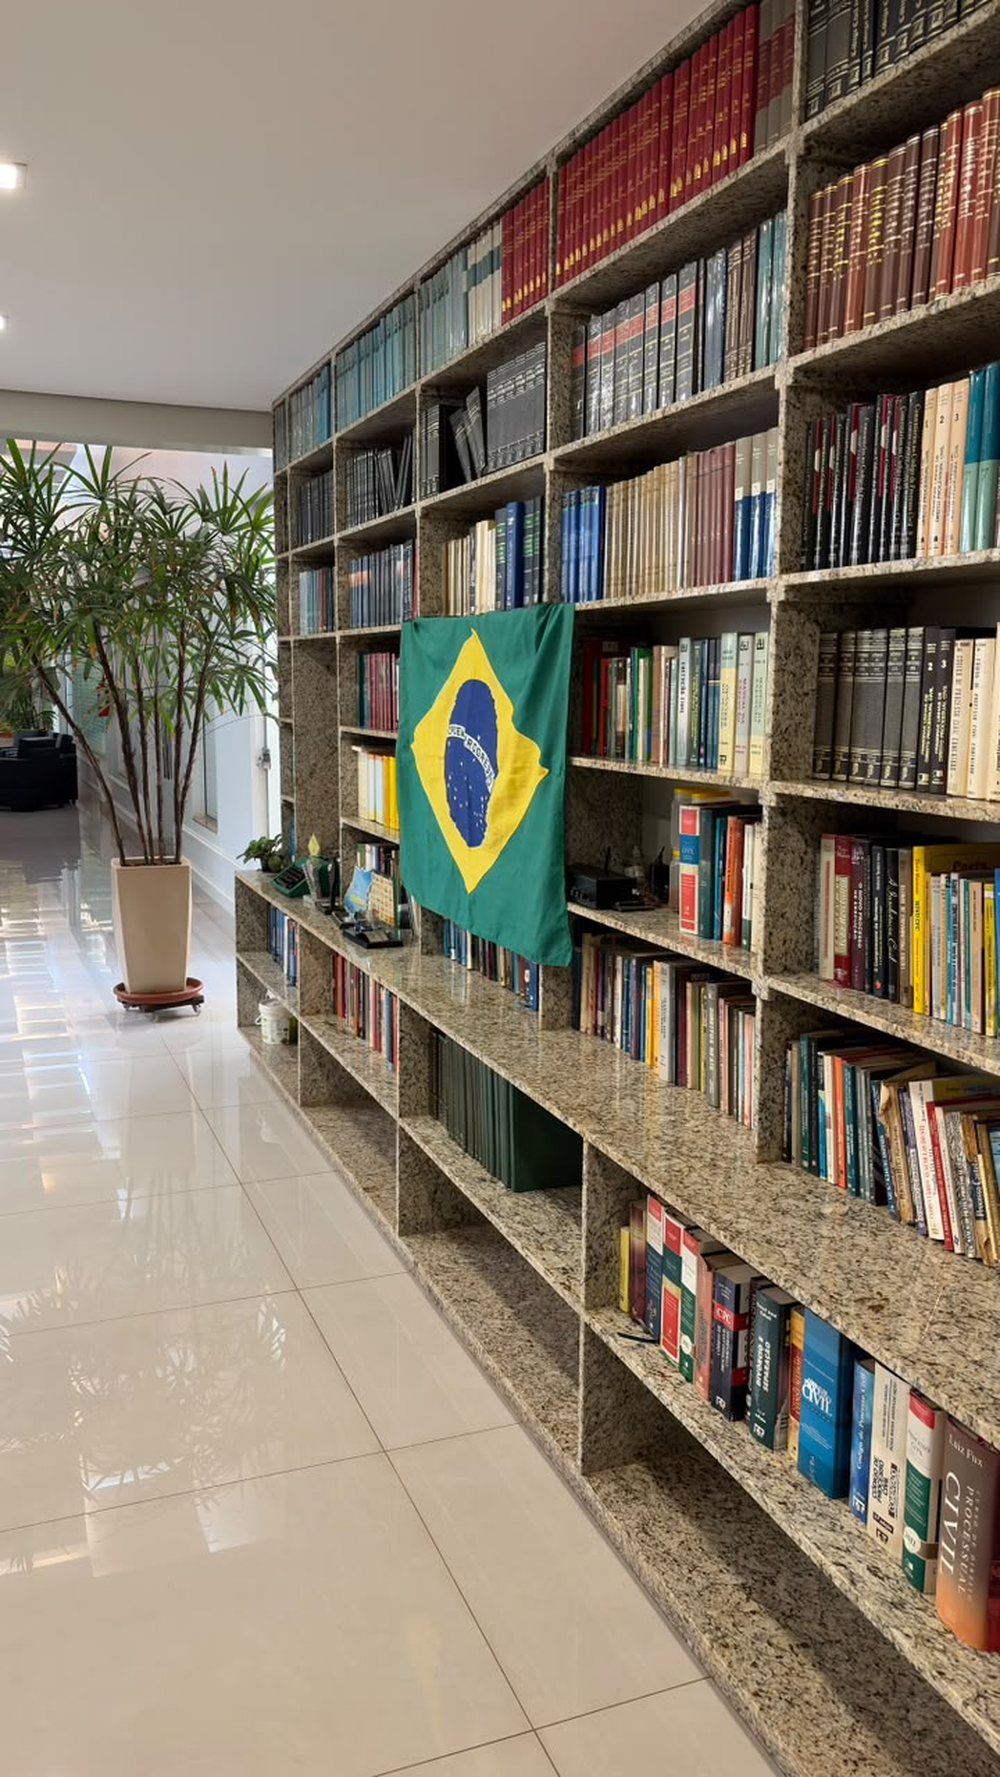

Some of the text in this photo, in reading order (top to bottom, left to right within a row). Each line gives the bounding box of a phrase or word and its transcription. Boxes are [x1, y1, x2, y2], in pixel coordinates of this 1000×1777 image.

[939, 414, 945, 424] 2
[954, 412, 960, 423] 3
[927, 662, 934, 671] 2
[940, 659, 947, 669] 3
[715, 1308, 732, 1324] CPC
[755, 1344, 764, 1387] DIVÓRCIO
[762, 1341, 771, 1392] SEPARAÇÃO
[949, 1434, 965, 1458] Luiz
[966, 1449, 983, 1467] Fux
[939, 1471, 961, 1575] CIVIL
[958, 1485, 975, 1594] PROCESSUAL
